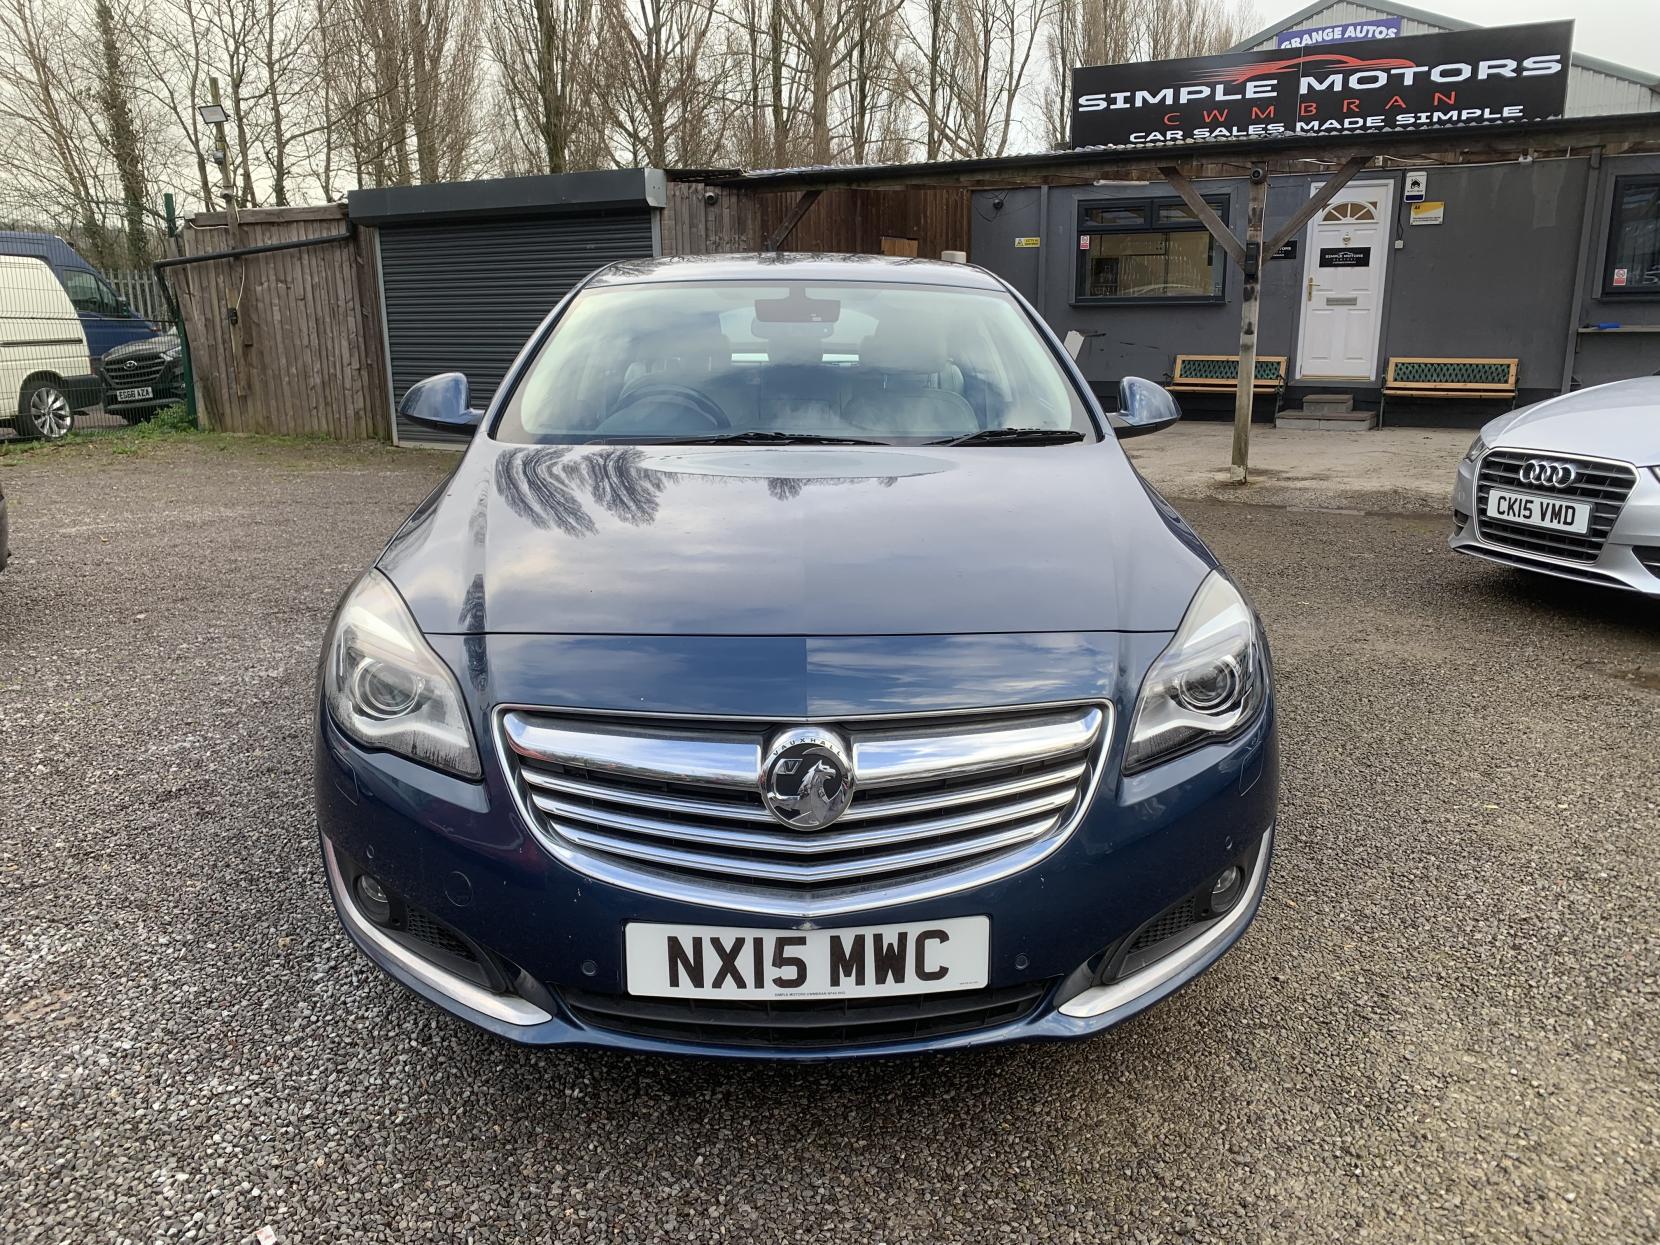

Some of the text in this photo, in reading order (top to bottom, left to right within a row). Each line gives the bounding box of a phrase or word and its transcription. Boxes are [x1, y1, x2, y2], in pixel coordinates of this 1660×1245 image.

[1281, 25, 1397, 48] GRANGE AUTOS
[1078, 54, 1562, 112] SIMPLE MOTORS
[1129, 105, 1524, 142] CAR SALES MADE SIMPLE
[1164, 91, 1457, 125] CWMBRAN
[1497, 496, 1576, 526] CK15 VMD
[773, 738, 841, 756] VAUXHALL
[666, 929, 950, 989] NX15 MWC
